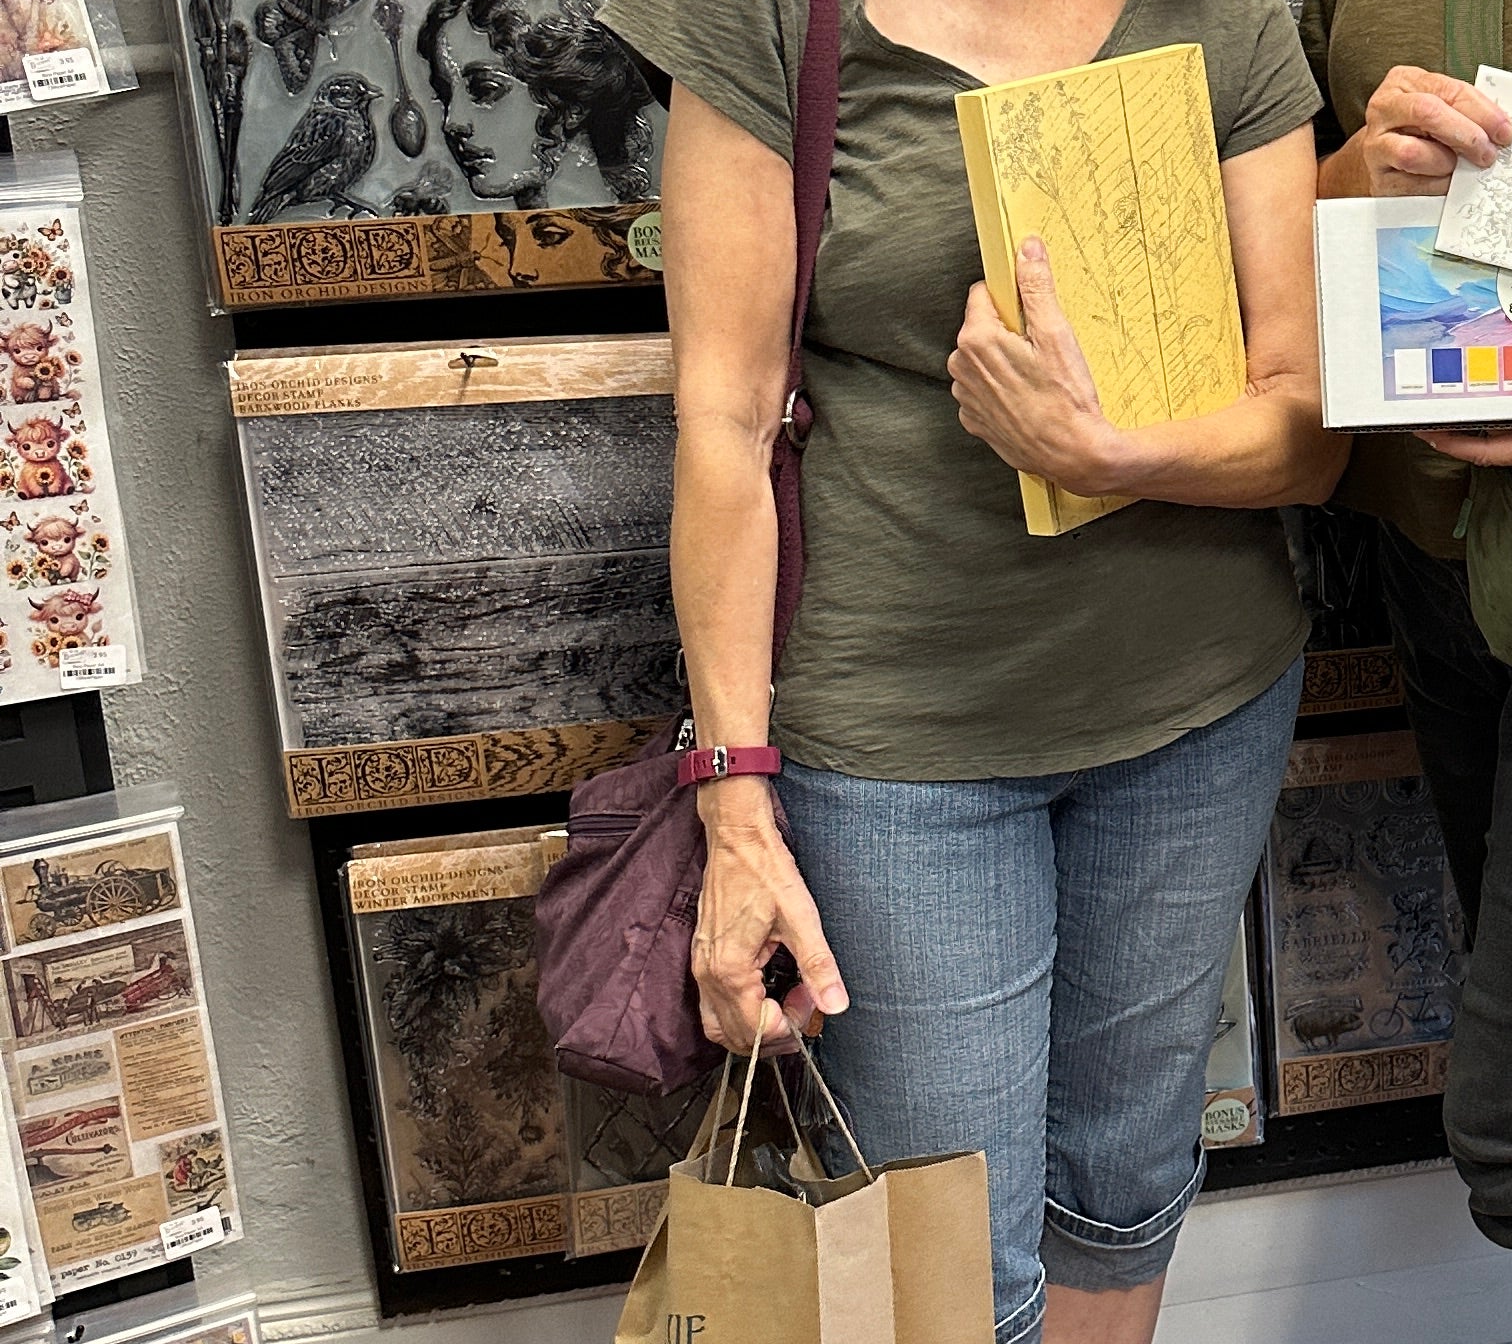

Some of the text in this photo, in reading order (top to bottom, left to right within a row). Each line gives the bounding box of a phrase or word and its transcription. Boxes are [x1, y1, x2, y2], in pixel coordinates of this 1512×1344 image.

[229, 278, 429, 304] IRON ORCHID DESIGNS
[271, 376, 322, 390] ORCHID
[238, 388, 325, 403] DECOR STAMP
[238, 397, 362, 415] BARNWOOD PLANKS
[297, 789, 489, 817] IRON ORCHID DESIGNS
[352, 872, 445, 891] IRON ORCHID
[353, 881, 449, 901] DECOR STAMP
[354, 887, 500, 911] WINTER ADORNMENT
[61, 1263, 90, 1279] paper
